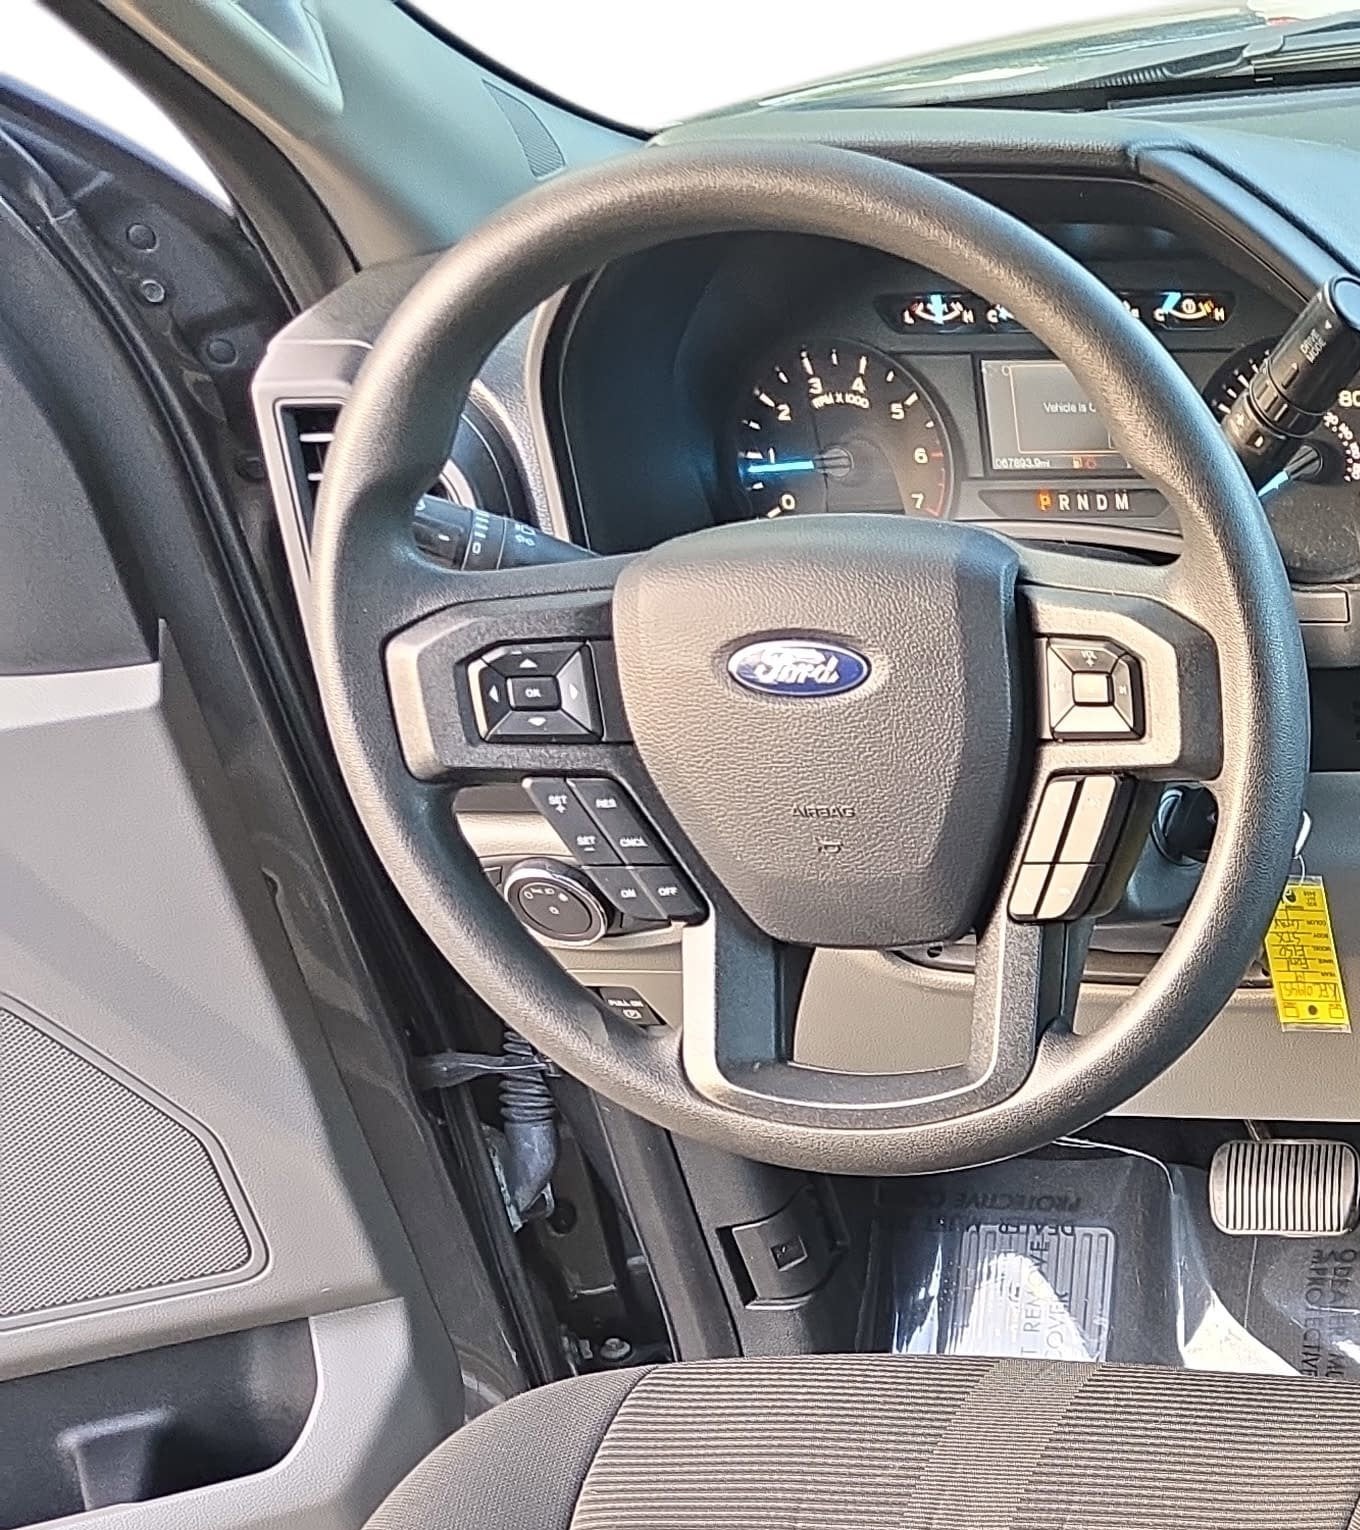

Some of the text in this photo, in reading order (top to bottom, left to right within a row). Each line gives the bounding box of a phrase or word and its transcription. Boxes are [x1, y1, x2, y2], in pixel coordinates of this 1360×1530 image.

[808, 377, 823, 394] 3
[851, 376, 866, 394] 4
[811, 393, 834, 409] RPM
[845, 393, 870, 409] 1000
[1043, 401, 1077, 413] Vehicle
[776, 404, 792, 421] 2
[890, 403, 905, 420] 5
[768, 447, 776, 464] 1
[913, 447, 928, 464] 6
[781, 493, 796, 511] 0
[911, 492, 924, 509] 7
[1039, 492, 1130, 511] P R N D M
[754, 649, 840, 684] Ford
[525, 687, 542, 699] OK
[548, 795, 568, 806] SET
[595, 798, 617, 809] RES
[791, 806, 857, 819] AIRBAG
[576, 835, 596, 846] SET
[619, 836, 649, 848] CNCL
[620, 888, 637, 899] ON
[657, 886, 678, 897] OFF
